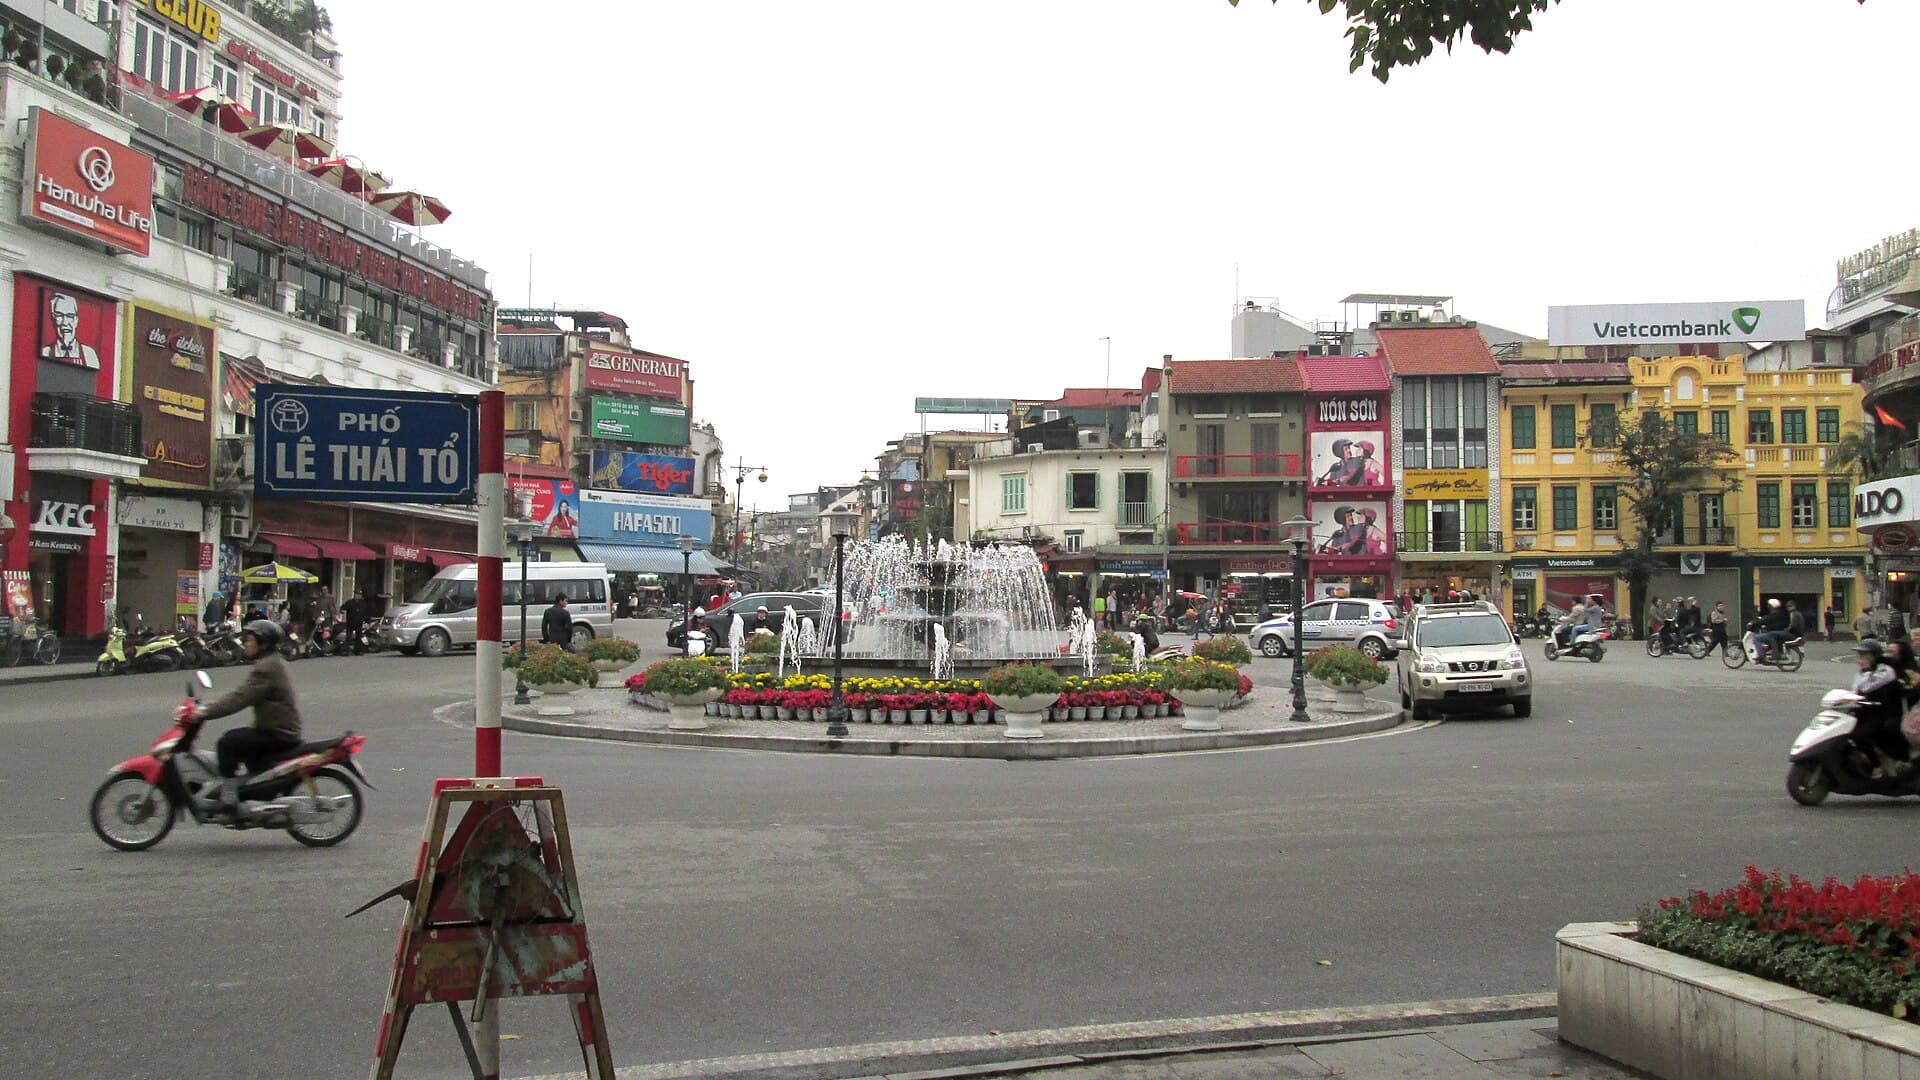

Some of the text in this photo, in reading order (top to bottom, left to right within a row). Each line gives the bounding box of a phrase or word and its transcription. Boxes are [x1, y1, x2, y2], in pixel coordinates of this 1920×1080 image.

[37, 173, 116, 220] Hanwha
[117, 204, 152, 233] Life
[1594, 319, 1731, 338] Vietcombank
[610, 355, 681, 378] GENERALI
[339, 406, 401, 433] PHỐ
[1319, 398, 1378, 422] NÓN SƠN
[276, 432, 460, 484] LÊ THÁI TỔ
[636, 462, 692, 490] Tiger
[38, 500, 96, 530] KFC
[613, 511, 681, 535] HAFASCO
[1548, 559, 1595, 567] Vietcombank
[1783, 558, 1832, 566] Vietcombank
